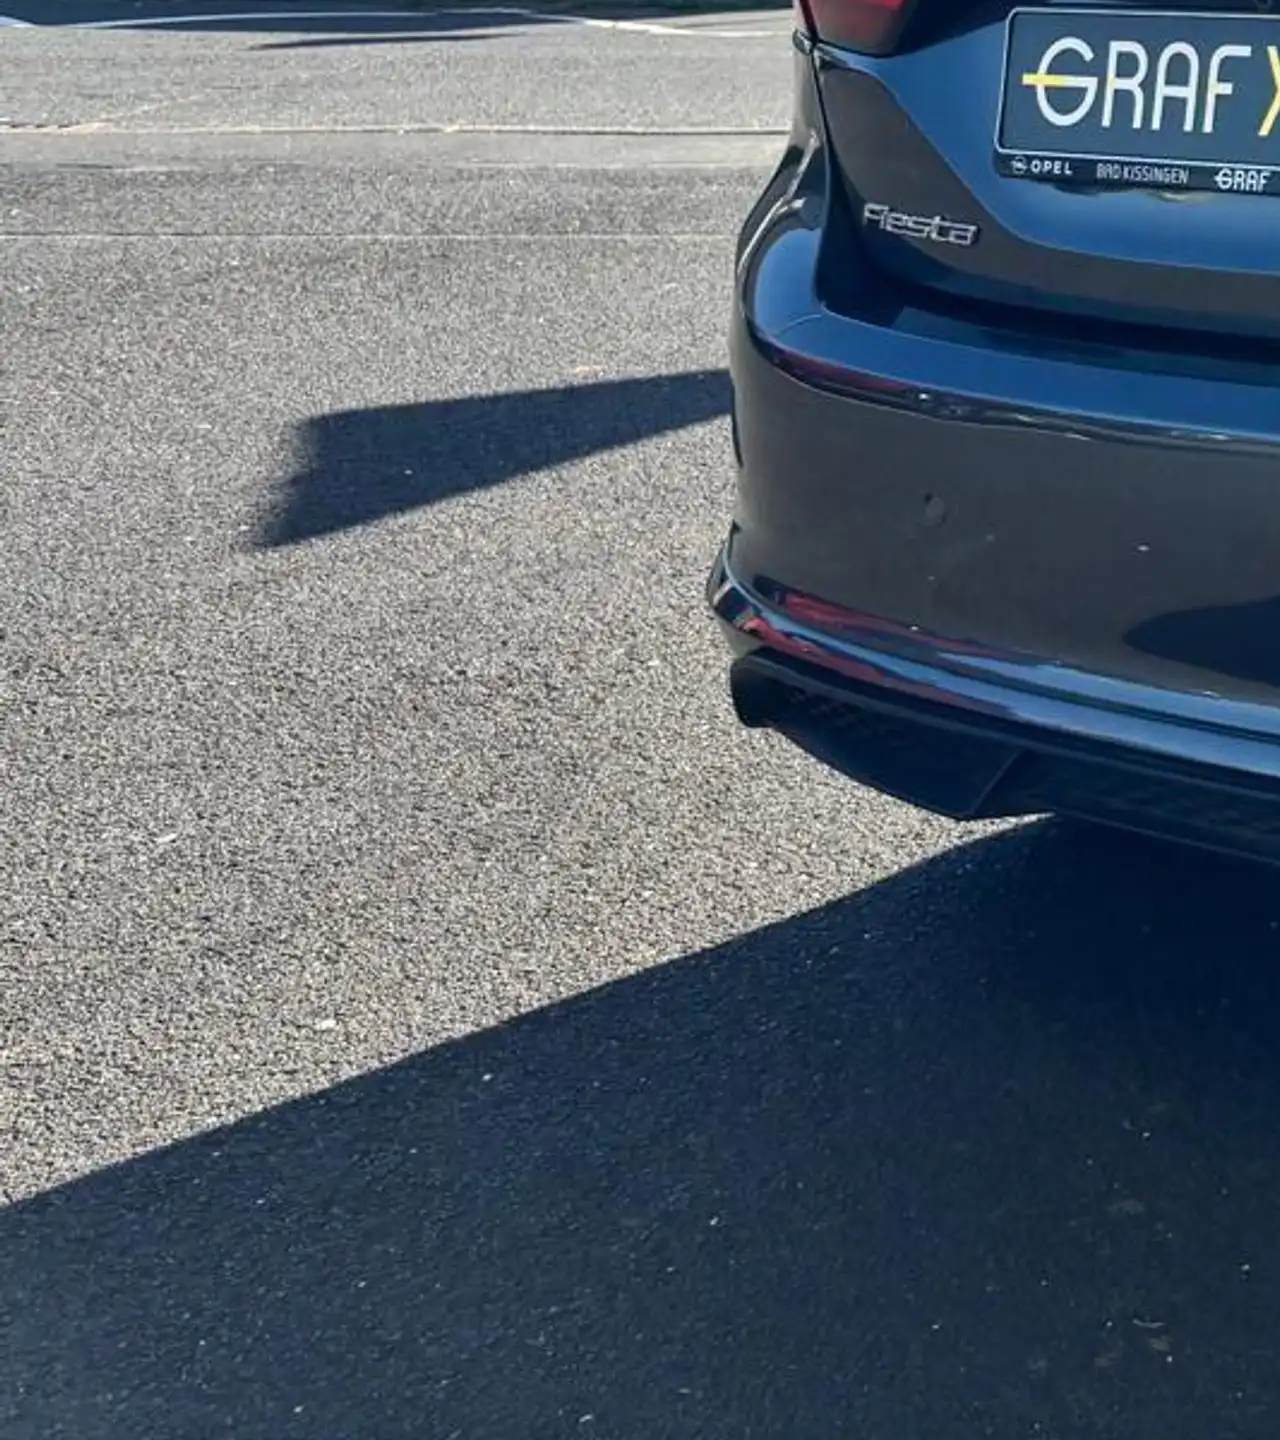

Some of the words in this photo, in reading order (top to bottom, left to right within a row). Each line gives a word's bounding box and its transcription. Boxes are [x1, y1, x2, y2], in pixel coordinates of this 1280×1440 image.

[1022, 35, 1252, 134] GRAF
[1030, 159, 1073, 176] OPEL
[1097, 164, 1121, 182] BAD
[1122, 165, 1189, 187] KISSINGEN
[1214, 167, 1271, 193] GRAF
[862, 200, 978, 247] Fiesta
